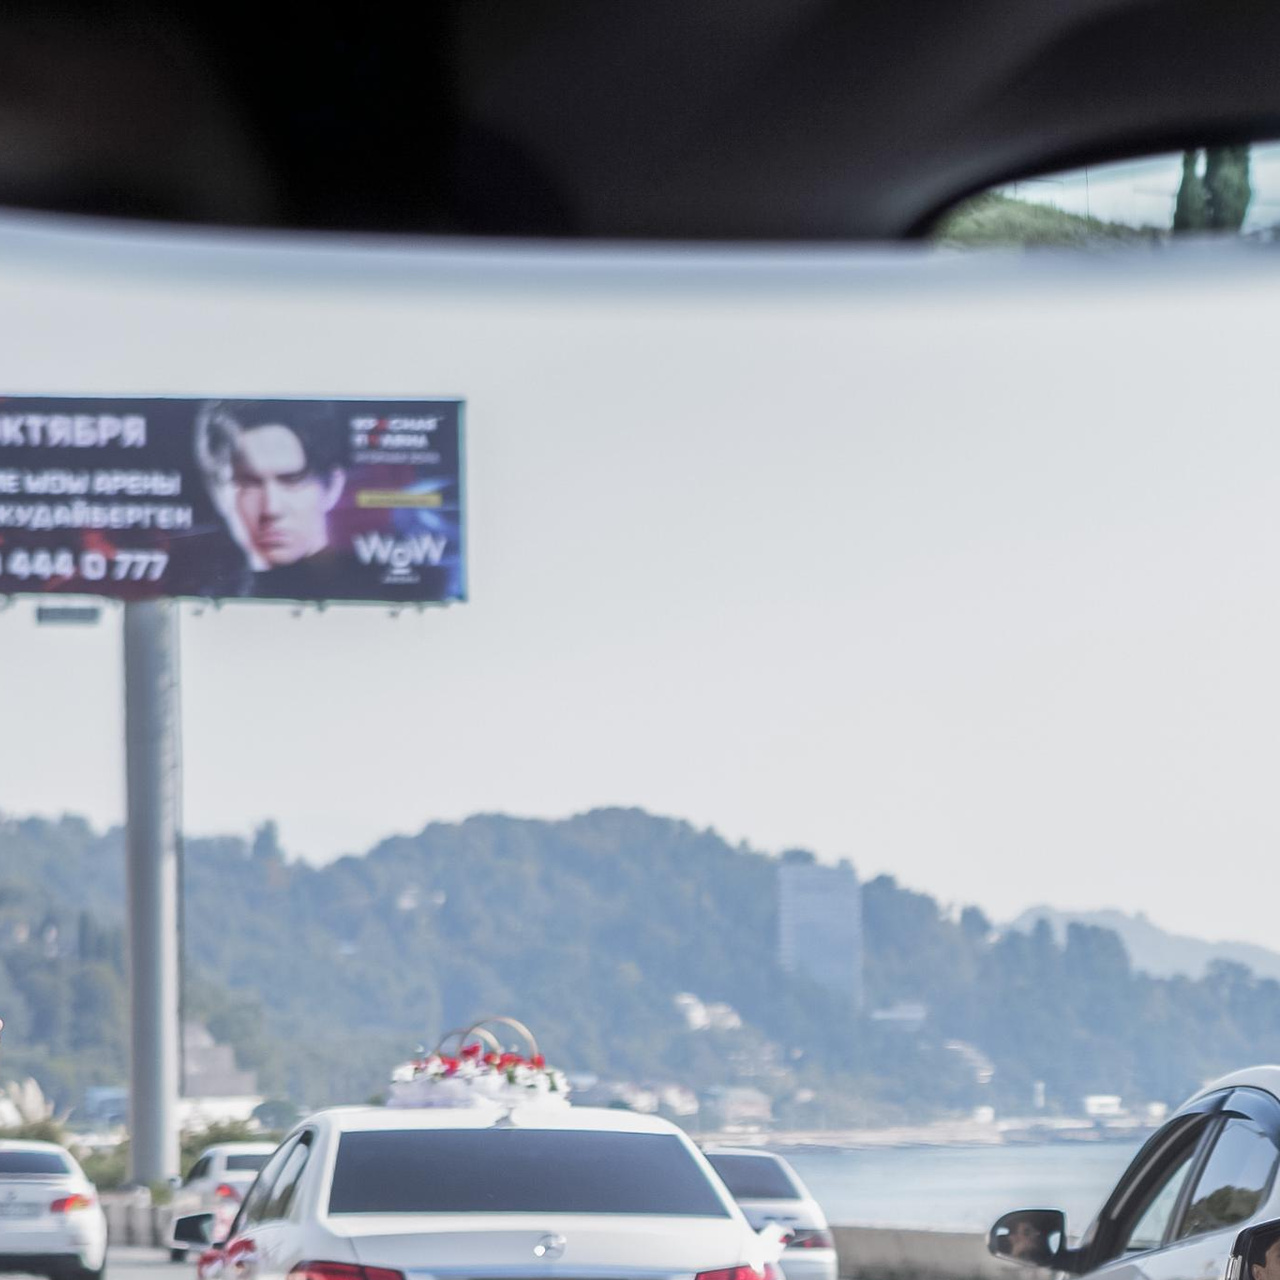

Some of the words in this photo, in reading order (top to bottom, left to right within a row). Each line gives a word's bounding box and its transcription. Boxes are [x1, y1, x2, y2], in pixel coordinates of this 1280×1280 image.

[93, 471, 181, 496] АРЕНЫ
[8, 550, 75, 580] 444
[112, 552, 169, 581] 777
